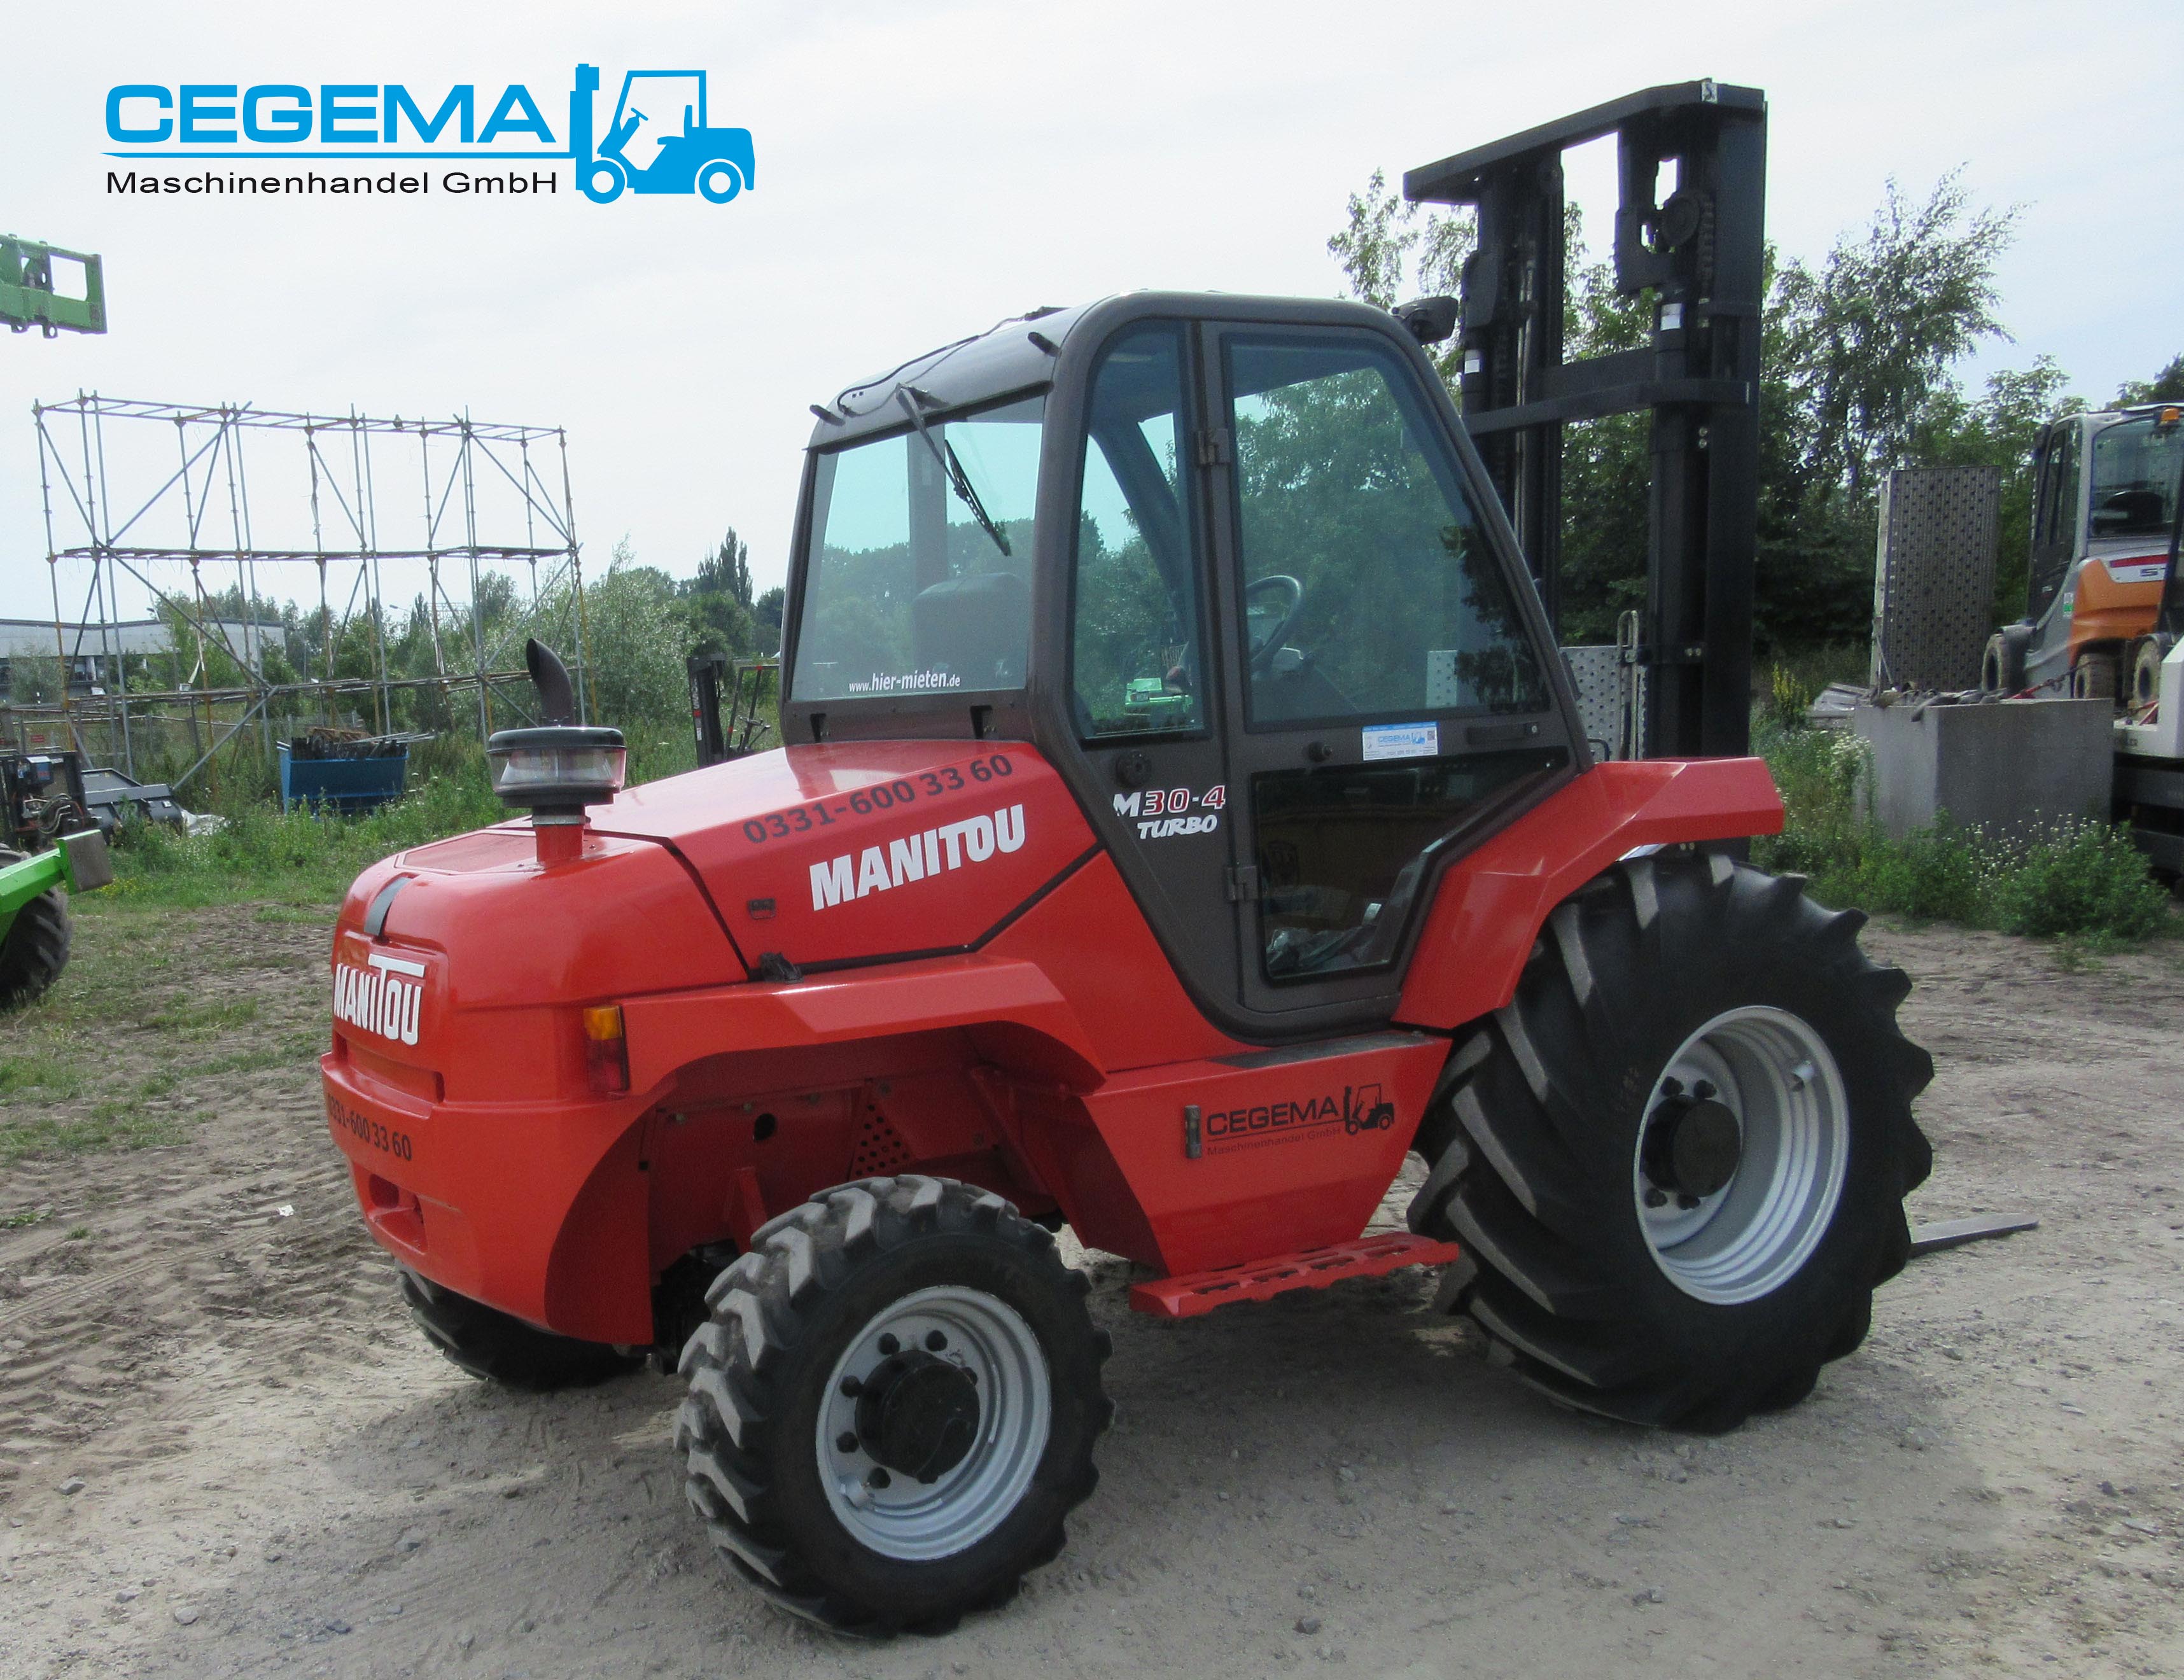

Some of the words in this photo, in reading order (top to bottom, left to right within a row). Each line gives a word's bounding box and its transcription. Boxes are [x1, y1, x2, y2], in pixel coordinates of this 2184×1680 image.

[849, 670, 960, 692] www.hier-mieten.de
[743, 780, 916, 844] 0331-600
[920, 766, 965, 797] 33
[970, 754, 1013, 782] 60
[1113, 785, 1226, 818] M30-4
[1137, 814, 1218, 839] TURBO
[809, 803, 1026, 912] MANITOU
[333, 953, 425, 1046] MANITOU
[1207, 1096, 1339, 1136] CEGEMA
[372, 1121, 389, 1152] 33
[392, 1131, 412, 1161] 60
